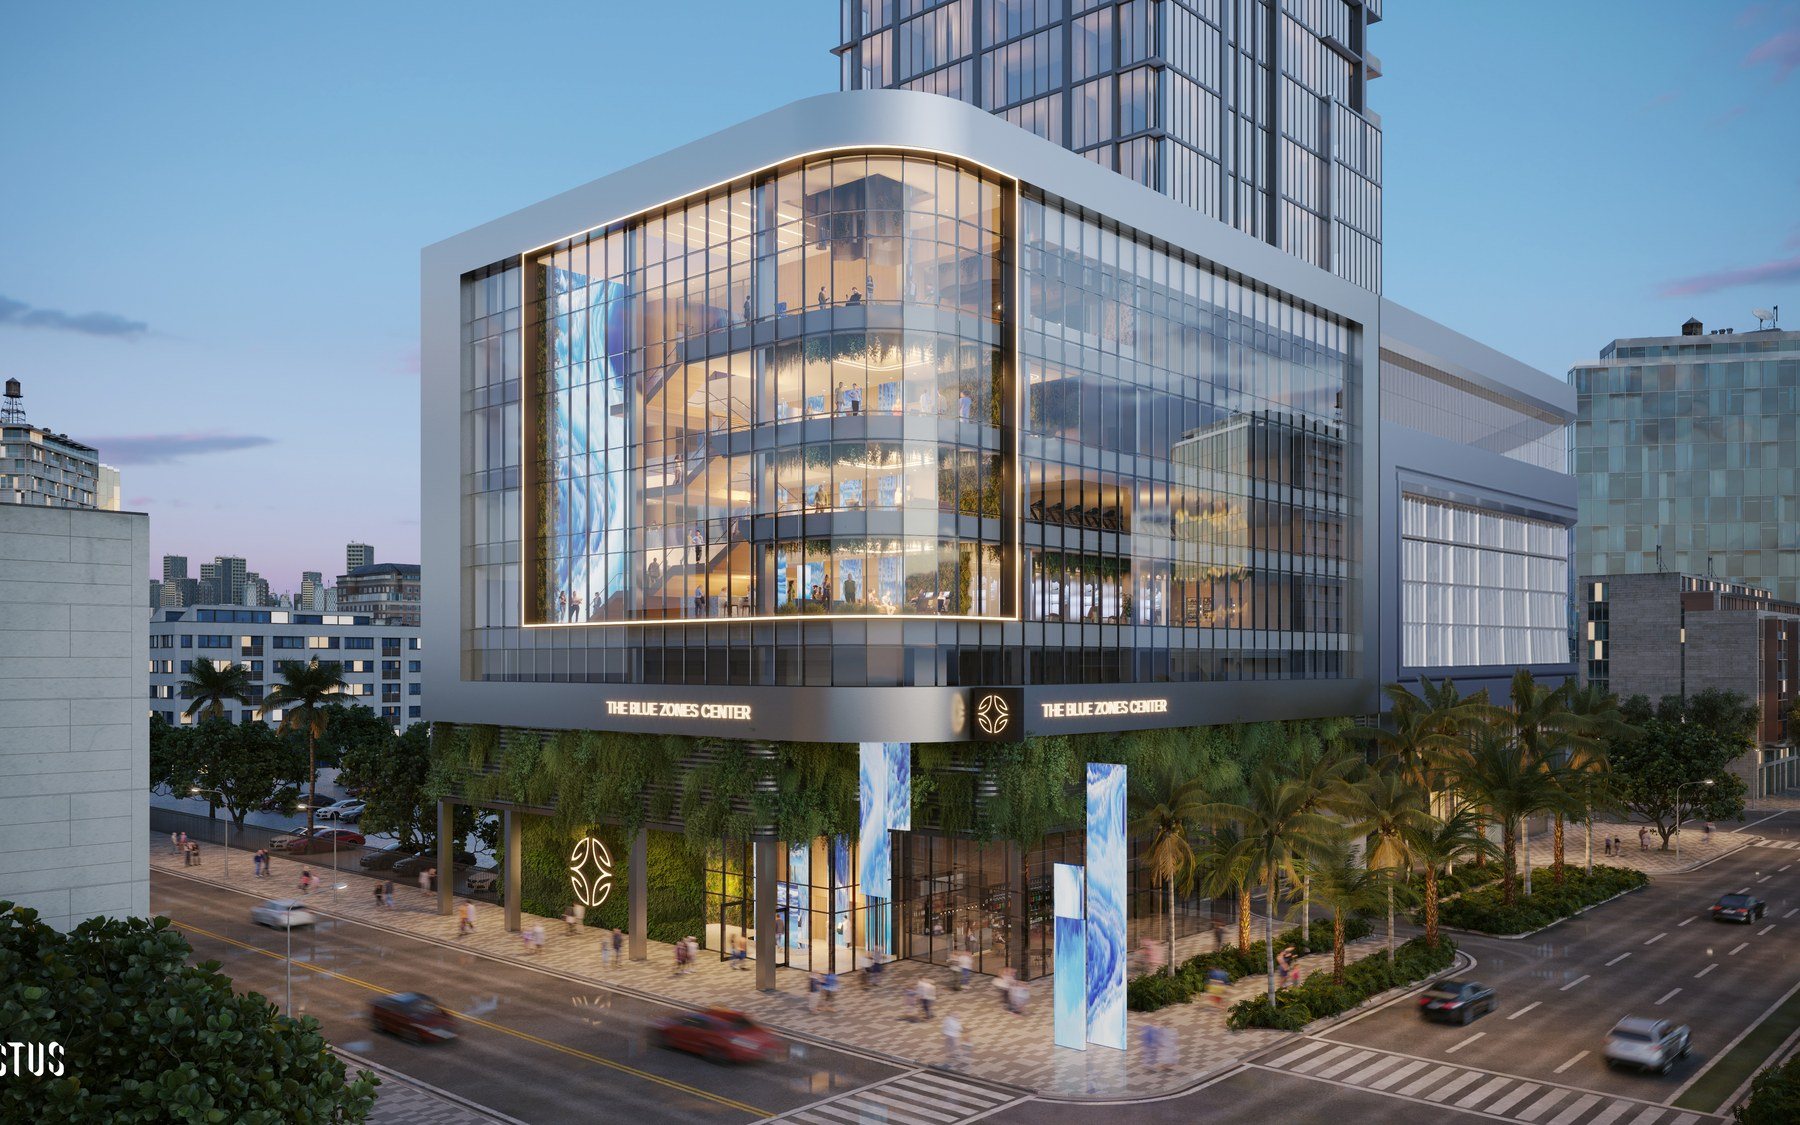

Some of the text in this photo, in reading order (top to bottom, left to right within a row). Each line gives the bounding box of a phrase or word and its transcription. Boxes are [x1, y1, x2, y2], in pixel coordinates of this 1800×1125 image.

[606, 701, 752, 720] THE BLUE ZONES CENTER
[1041, 699, 1168, 718] THE BLUE ZONES CENTER
